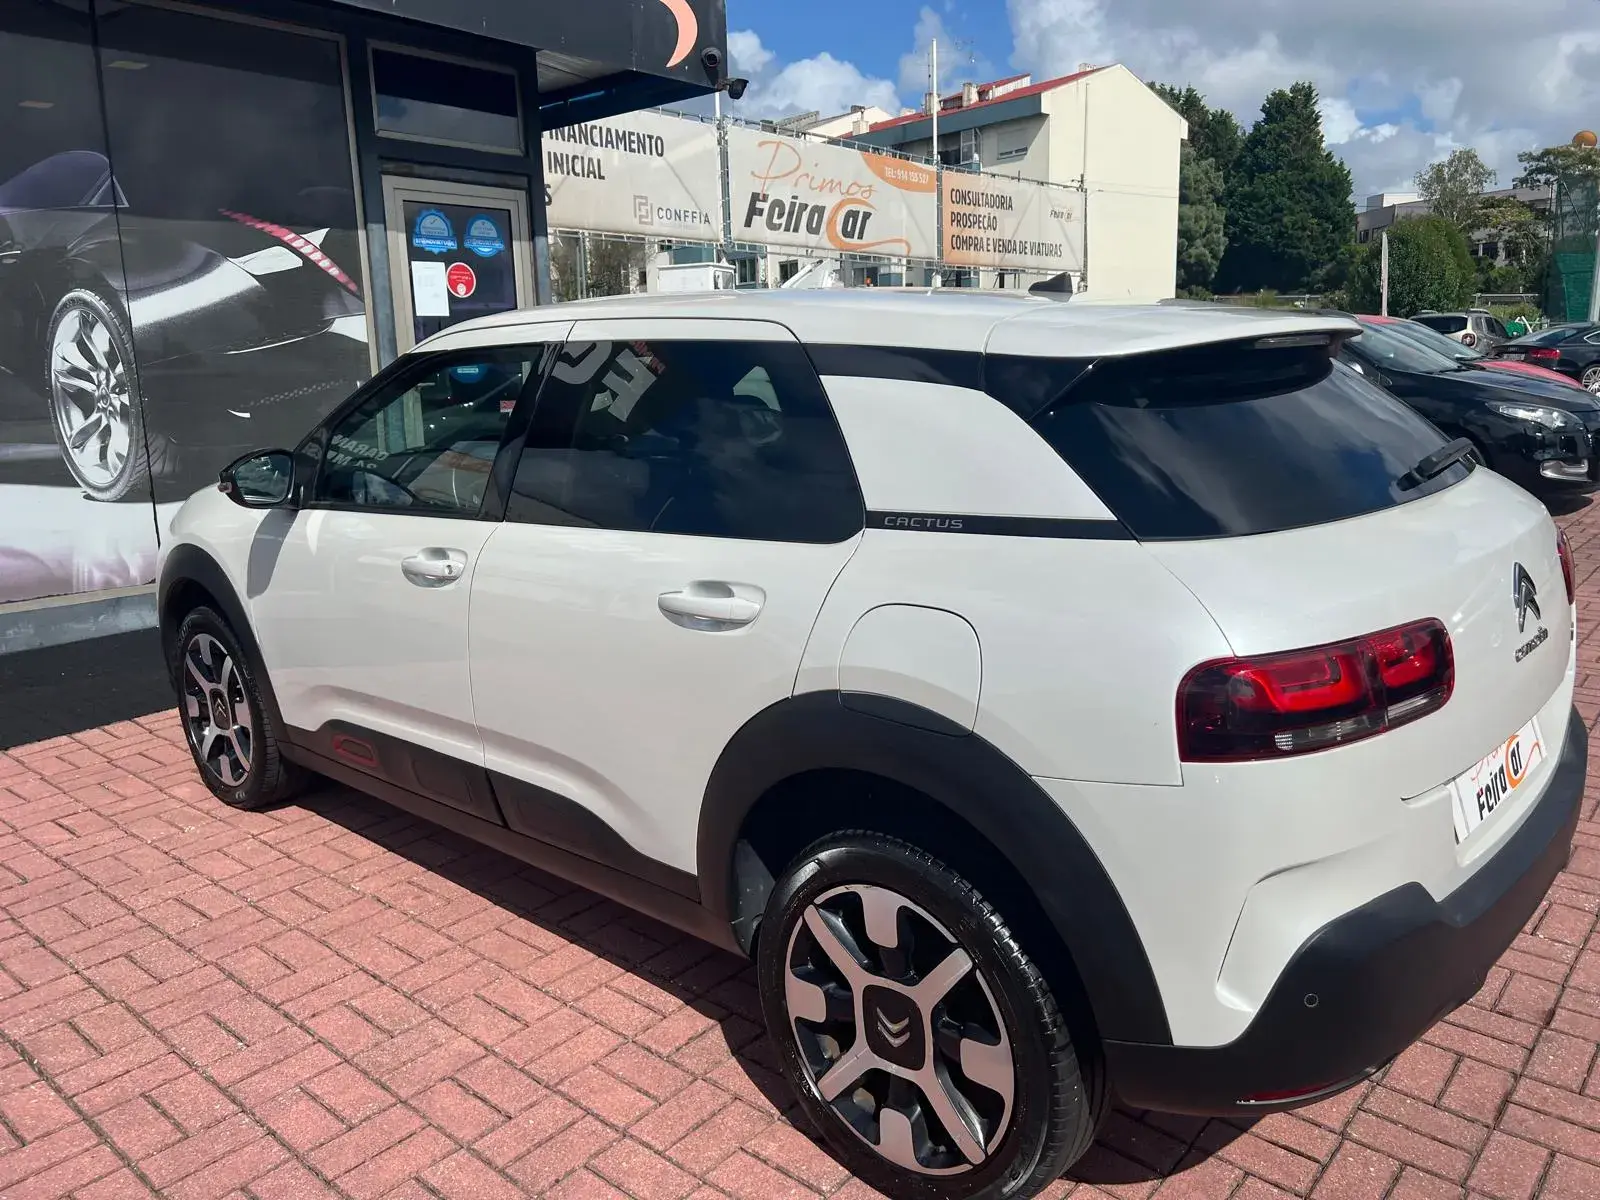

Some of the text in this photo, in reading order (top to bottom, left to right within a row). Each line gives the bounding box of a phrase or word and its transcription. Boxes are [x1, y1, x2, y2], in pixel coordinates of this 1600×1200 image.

[541, 124, 664, 158] NANCIAMENTO
[547, 151, 606, 180] INICIAL
[750, 140, 878, 201] Primos
[950, 188, 1014, 211] CONSULTADORIA
[657, 206, 712, 225] CONFFIA
[950, 211, 998, 233] PROSPEÇÃO
[951, 234, 1063, 258] COMPRA E VENDA DE VIATURAS
[884, 516, 963, 529] CACTUS
